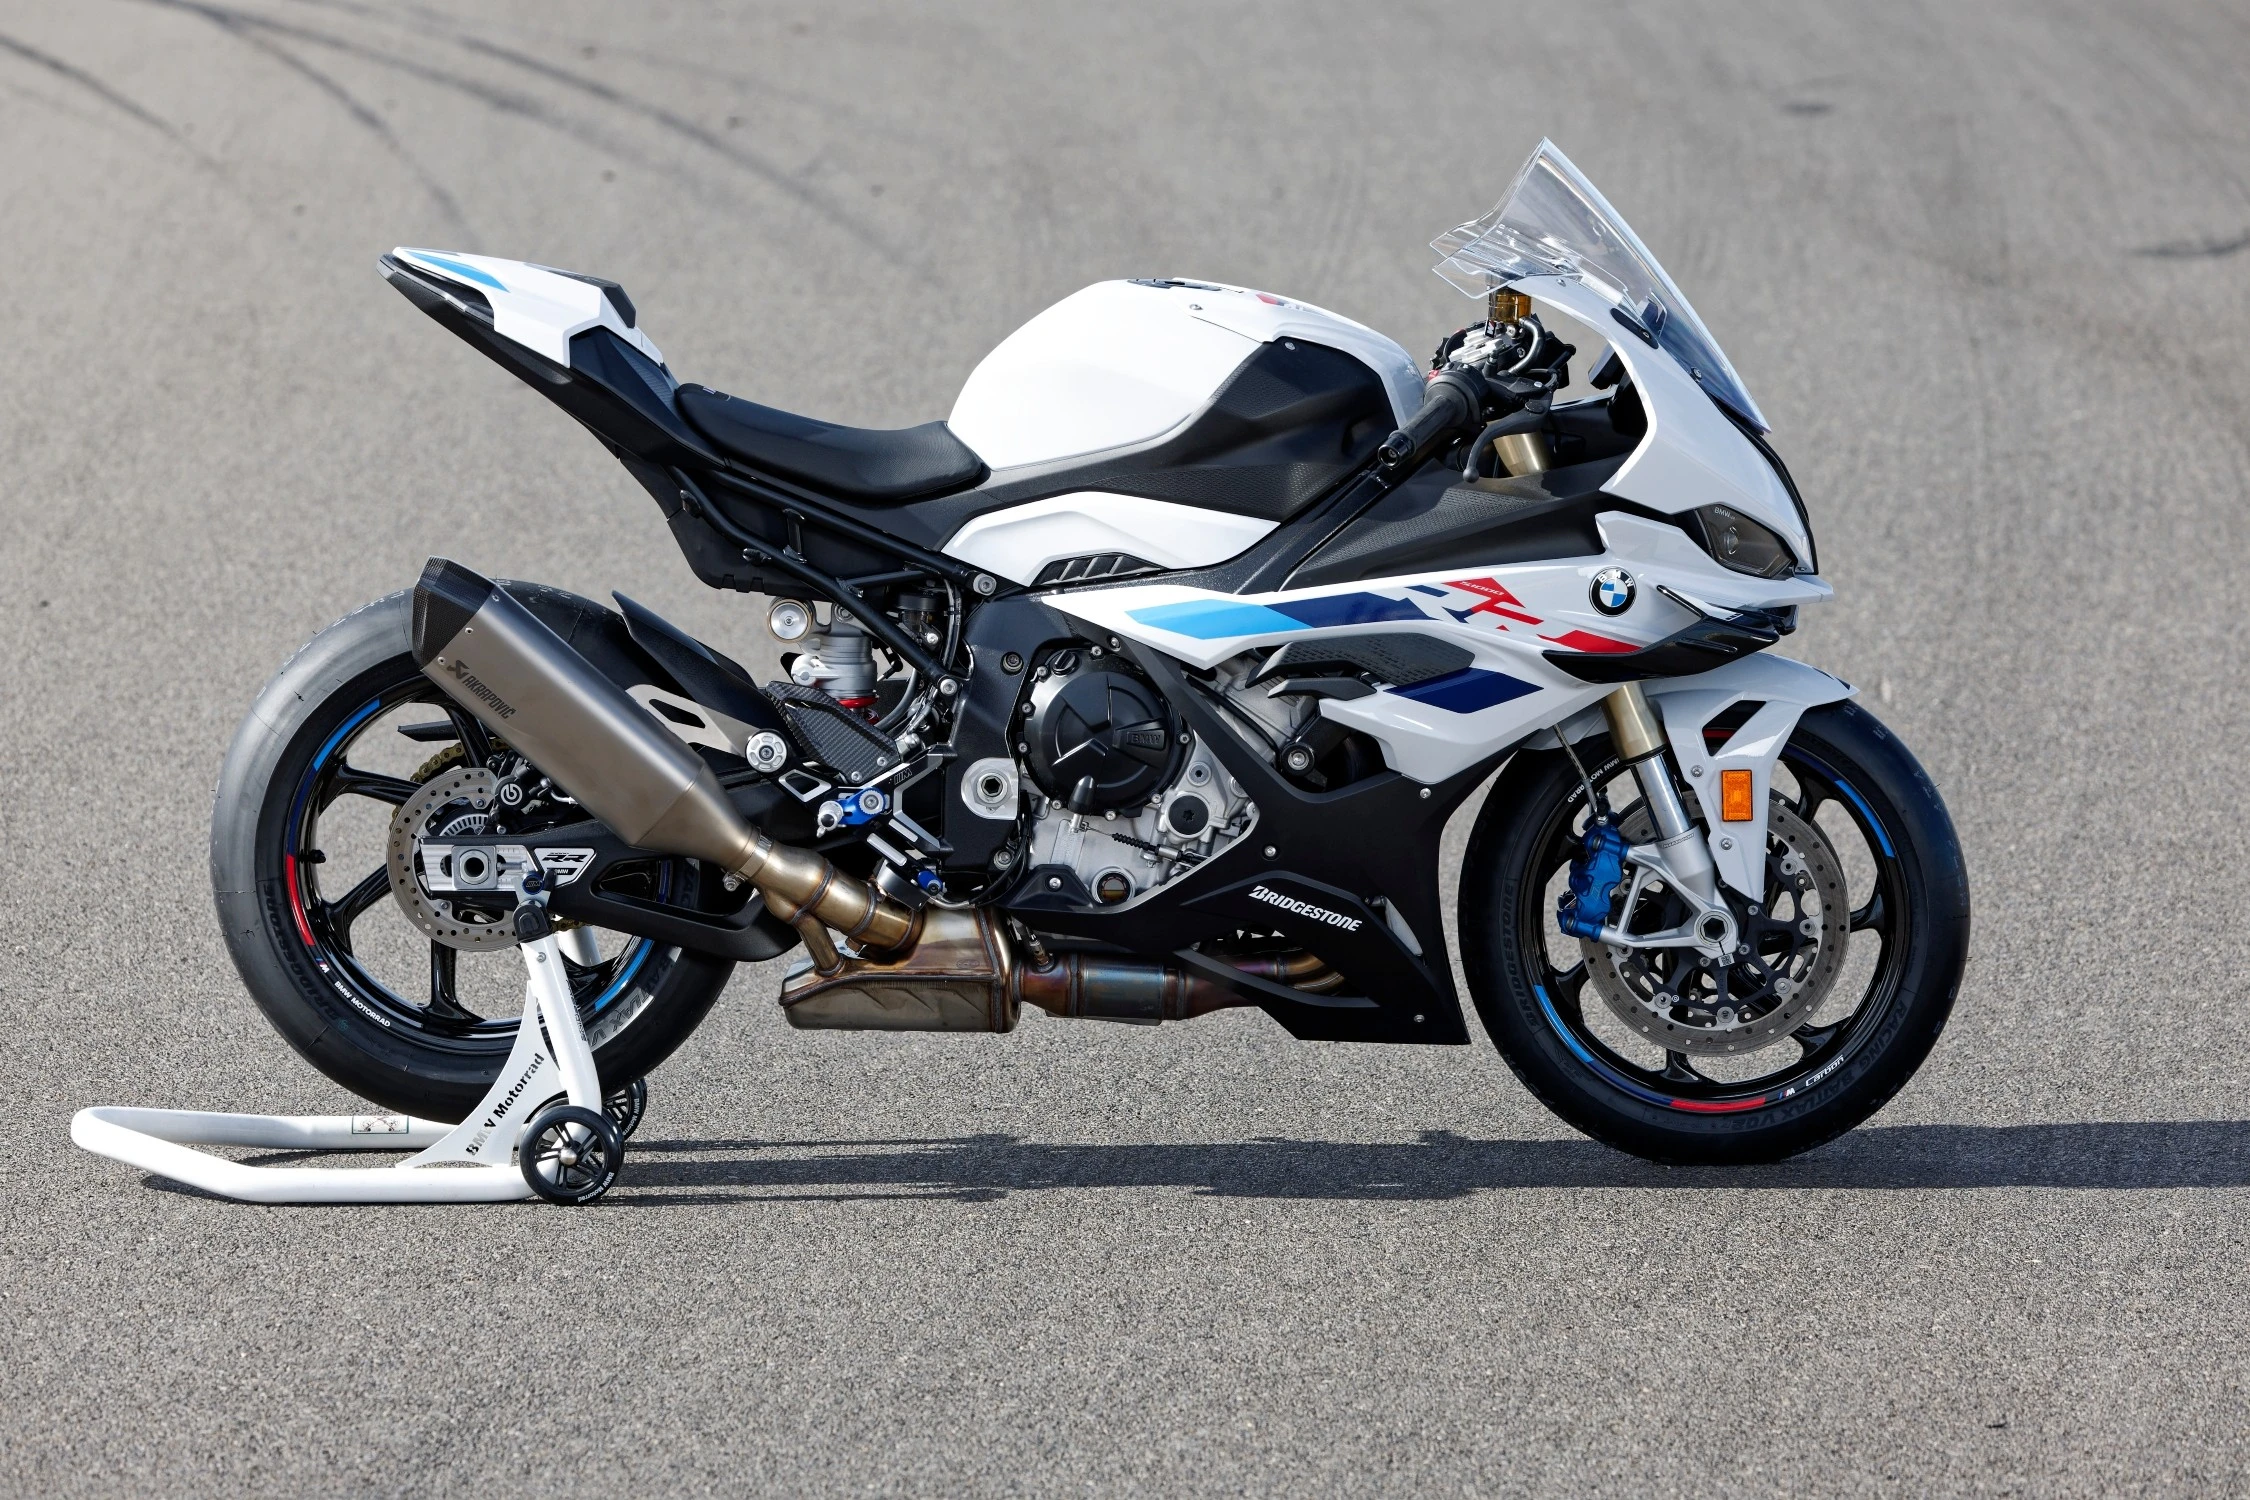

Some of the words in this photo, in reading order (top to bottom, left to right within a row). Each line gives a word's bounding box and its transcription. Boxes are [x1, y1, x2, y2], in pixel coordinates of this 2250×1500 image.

[1713, 507, 1731, 518] BMW
[1598, 570, 1635, 587] BMW
[1131, 733, 1161, 745] BMW
[1567, 768, 1604, 803] MORRAD
[1248, 885, 1363, 932] BRIDGESTONE
[1503, 884, 1537, 1027] BRIDGESTONE
[334, 981, 352, 999] BMW
[351, 997, 391, 1027] MOTORRAD
[1858, 1001, 1907, 1071] RACING
[493, 1053, 545, 1119] Motorrad
[1805, 1054, 1845, 1087] Carbon
[577, 1186, 604, 1202] Motorrad
[602, 1171, 615, 1187] BMW
